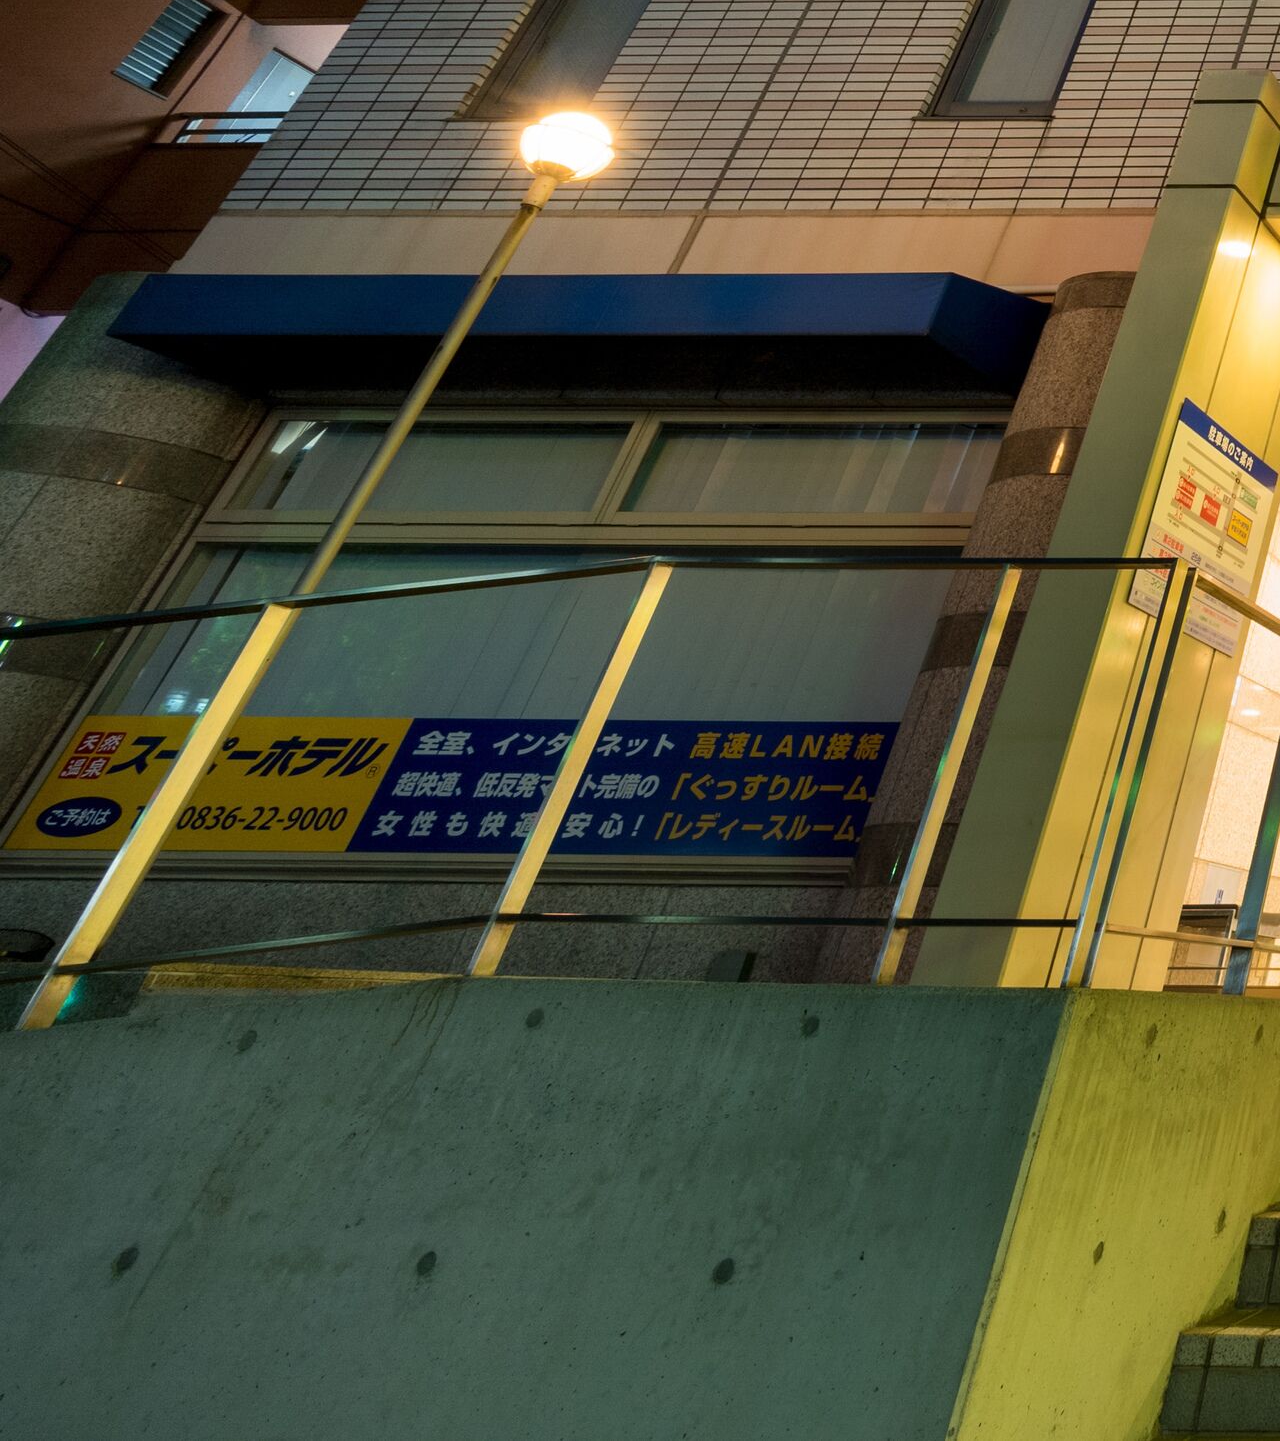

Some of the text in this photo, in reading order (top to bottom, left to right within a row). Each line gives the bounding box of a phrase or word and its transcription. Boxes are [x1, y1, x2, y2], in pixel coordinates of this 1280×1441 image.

[412, 730, 675, 758] 全室、インタネット
[43, 807, 112, 827] ご予約は
